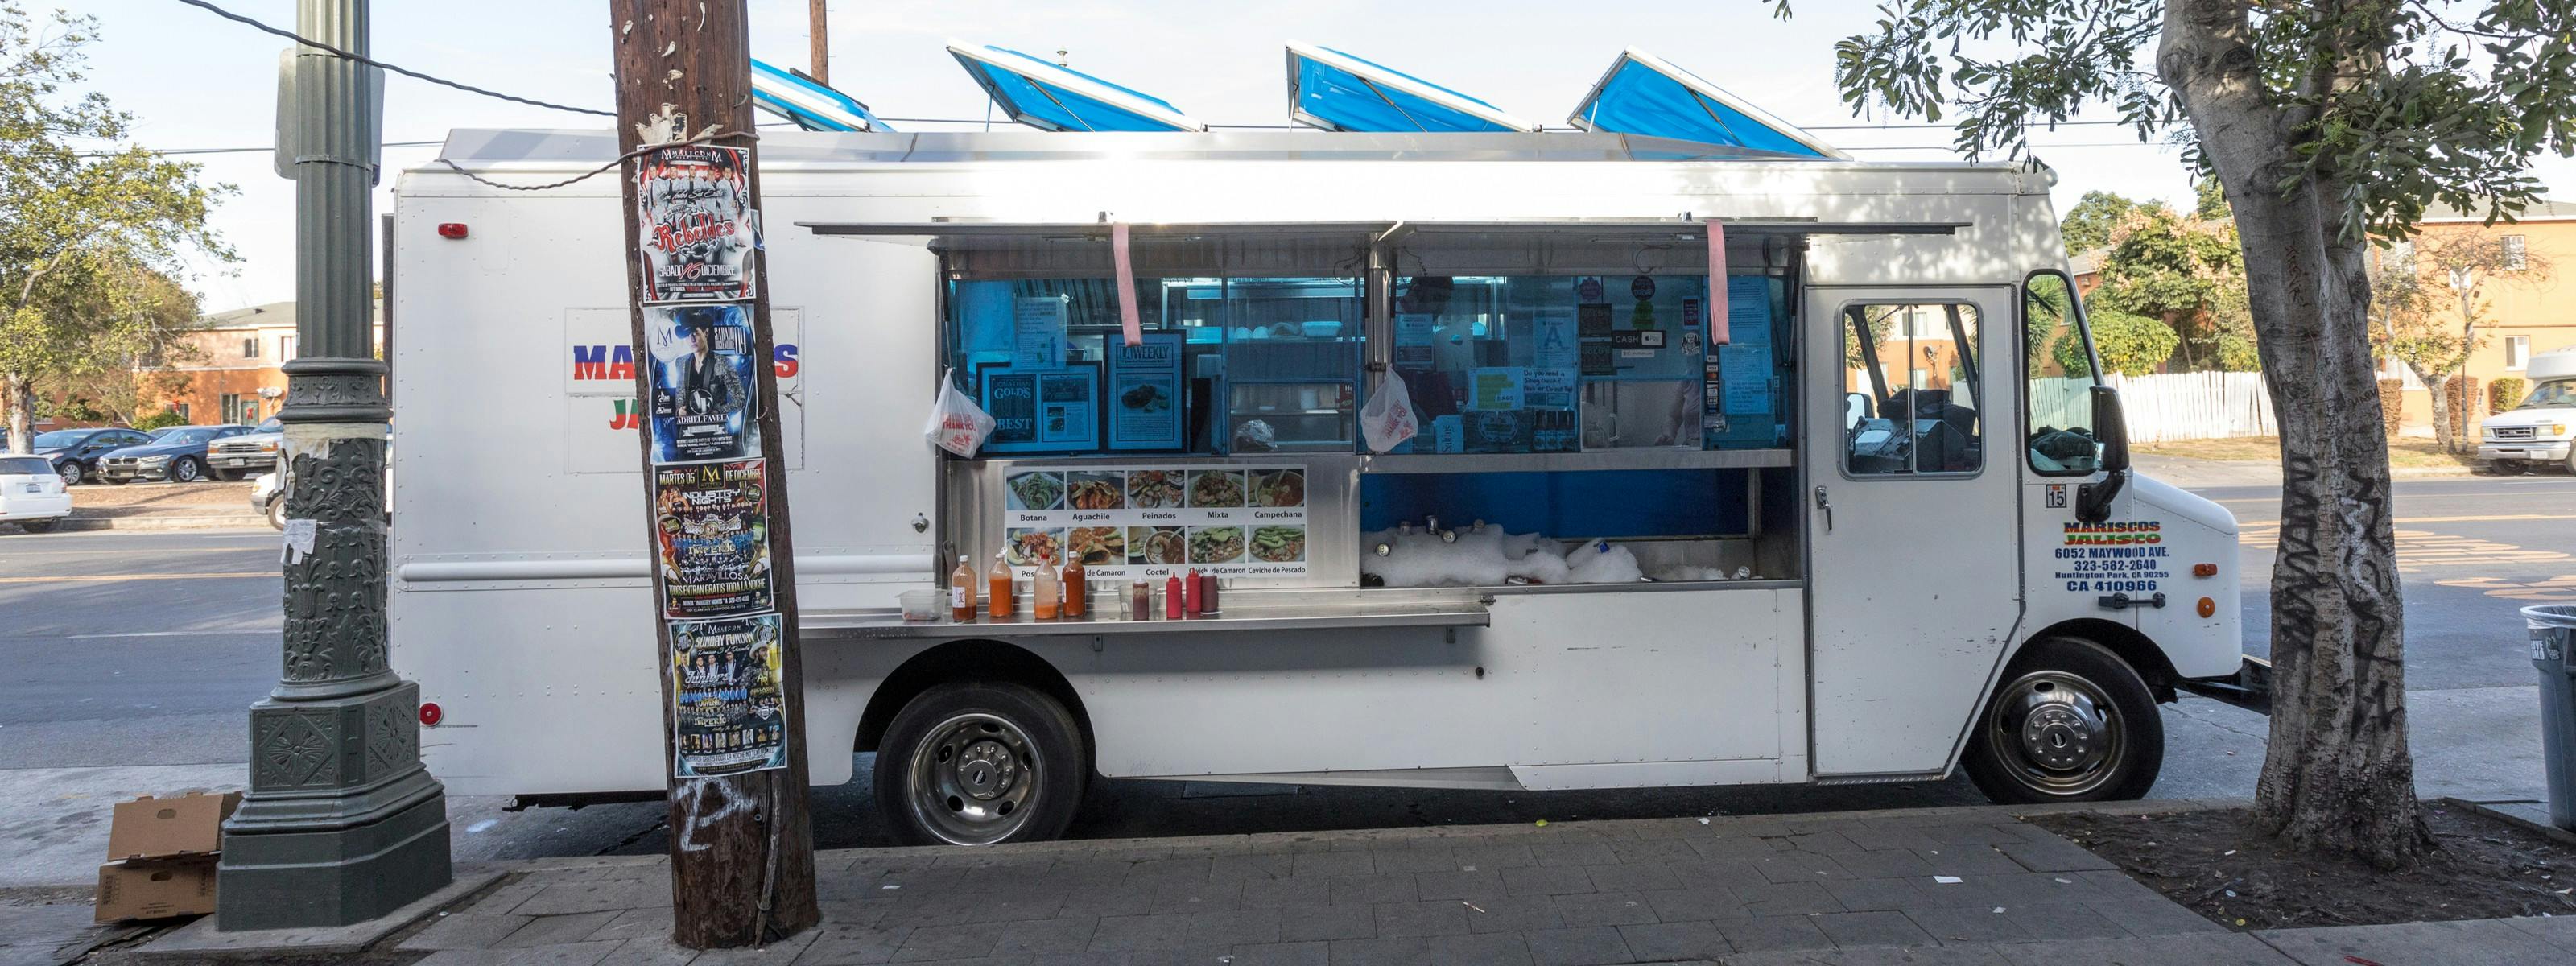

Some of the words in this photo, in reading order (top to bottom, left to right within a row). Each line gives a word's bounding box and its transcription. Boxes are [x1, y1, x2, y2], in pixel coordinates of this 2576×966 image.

[652, 208, 736, 254] Rebeldes
[701, 264, 736, 276] DICIEMBRE
[1544, 325, 1563, 347] A
[1133, 345, 1170, 360] WEEKLY
[994, 387, 1031, 399] GOLD'S
[997, 418, 1032, 431] BEST
[659, 473, 684, 485] MARTES
[725, 471, 733, 481] DE
[734, 468, 762, 481] DICIEMBRE
[682, 488, 741, 499] INDUSTRY
[2049, 490, 2065, 506] 15
[691, 497, 732, 506] NIGHTS
[1072, 513, 1110, 522] Aguachile
[1254, 511, 1302, 520] Campechana
[2063, 521, 2161, 533] MARISCOS
[2064, 534, 2161, 545] JALISCO
[2054, 547, 2086, 559] 6052
[2088, 547, 2145, 559] MAYWOOD
[2149, 547, 2170, 557] AVE.
[2074, 559, 2157, 571] 323-582-2640
[682, 572, 750, 584] MARAVILLOSA
[1146, 568, 1169, 576] Coctel
[2055, 572, 2105, 580] Huntington
[683, 584, 704, 596] ENTRAN
[2066, 580, 2090, 592] CA
[2094, 580, 2157, 592] 410966
[695, 634, 725, 647] SUNDAY
[725, 632, 755, 646] FUNDAY
